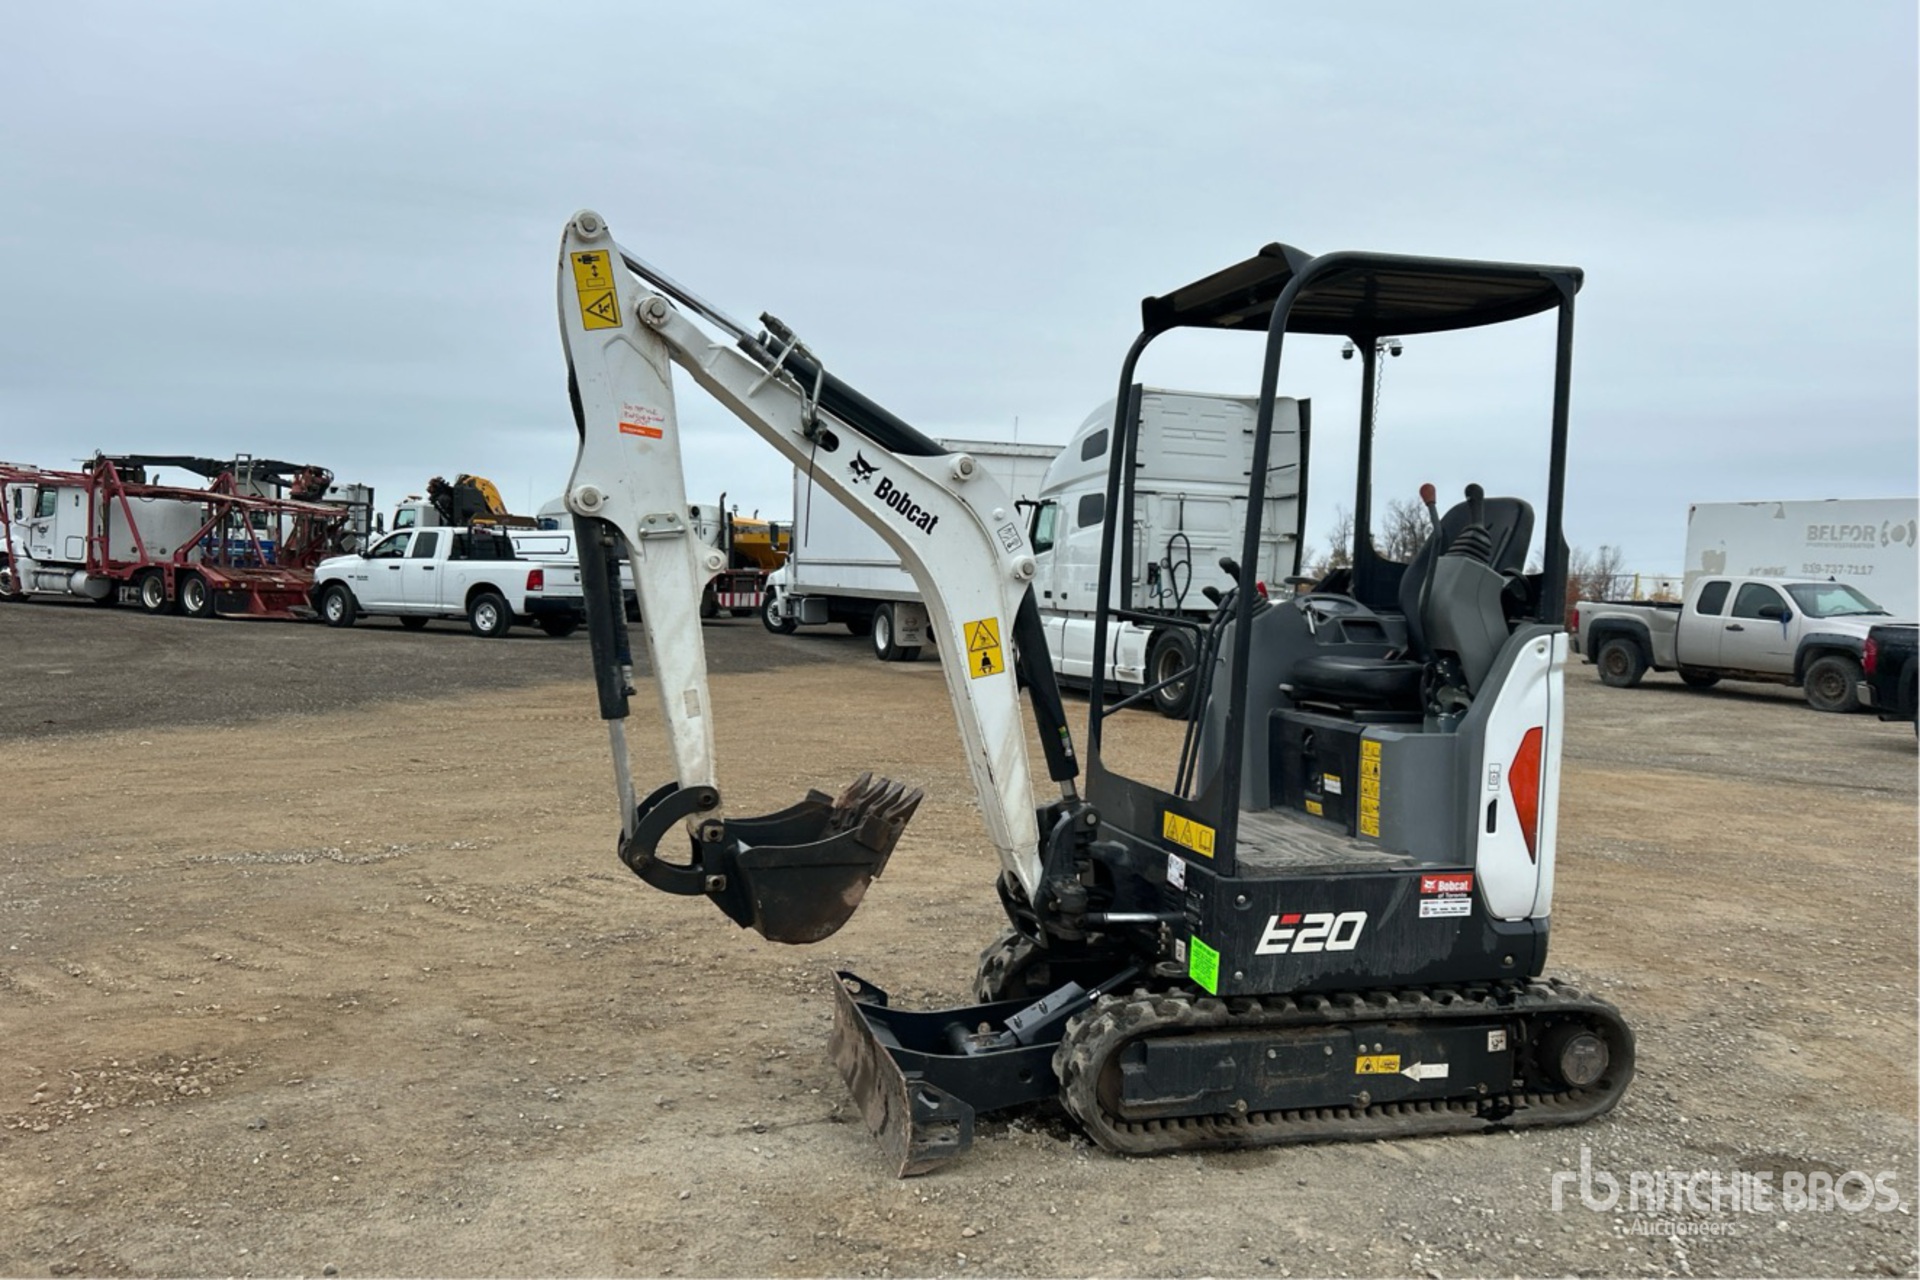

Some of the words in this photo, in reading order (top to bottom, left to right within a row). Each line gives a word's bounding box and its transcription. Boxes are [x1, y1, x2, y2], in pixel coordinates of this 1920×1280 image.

[874, 476, 939, 535] Bobcat
[1807, 525, 1876, 541] BELFOR
[1438, 881, 1468, 891] Bobcat
[1255, 911, 1368, 955] E20
